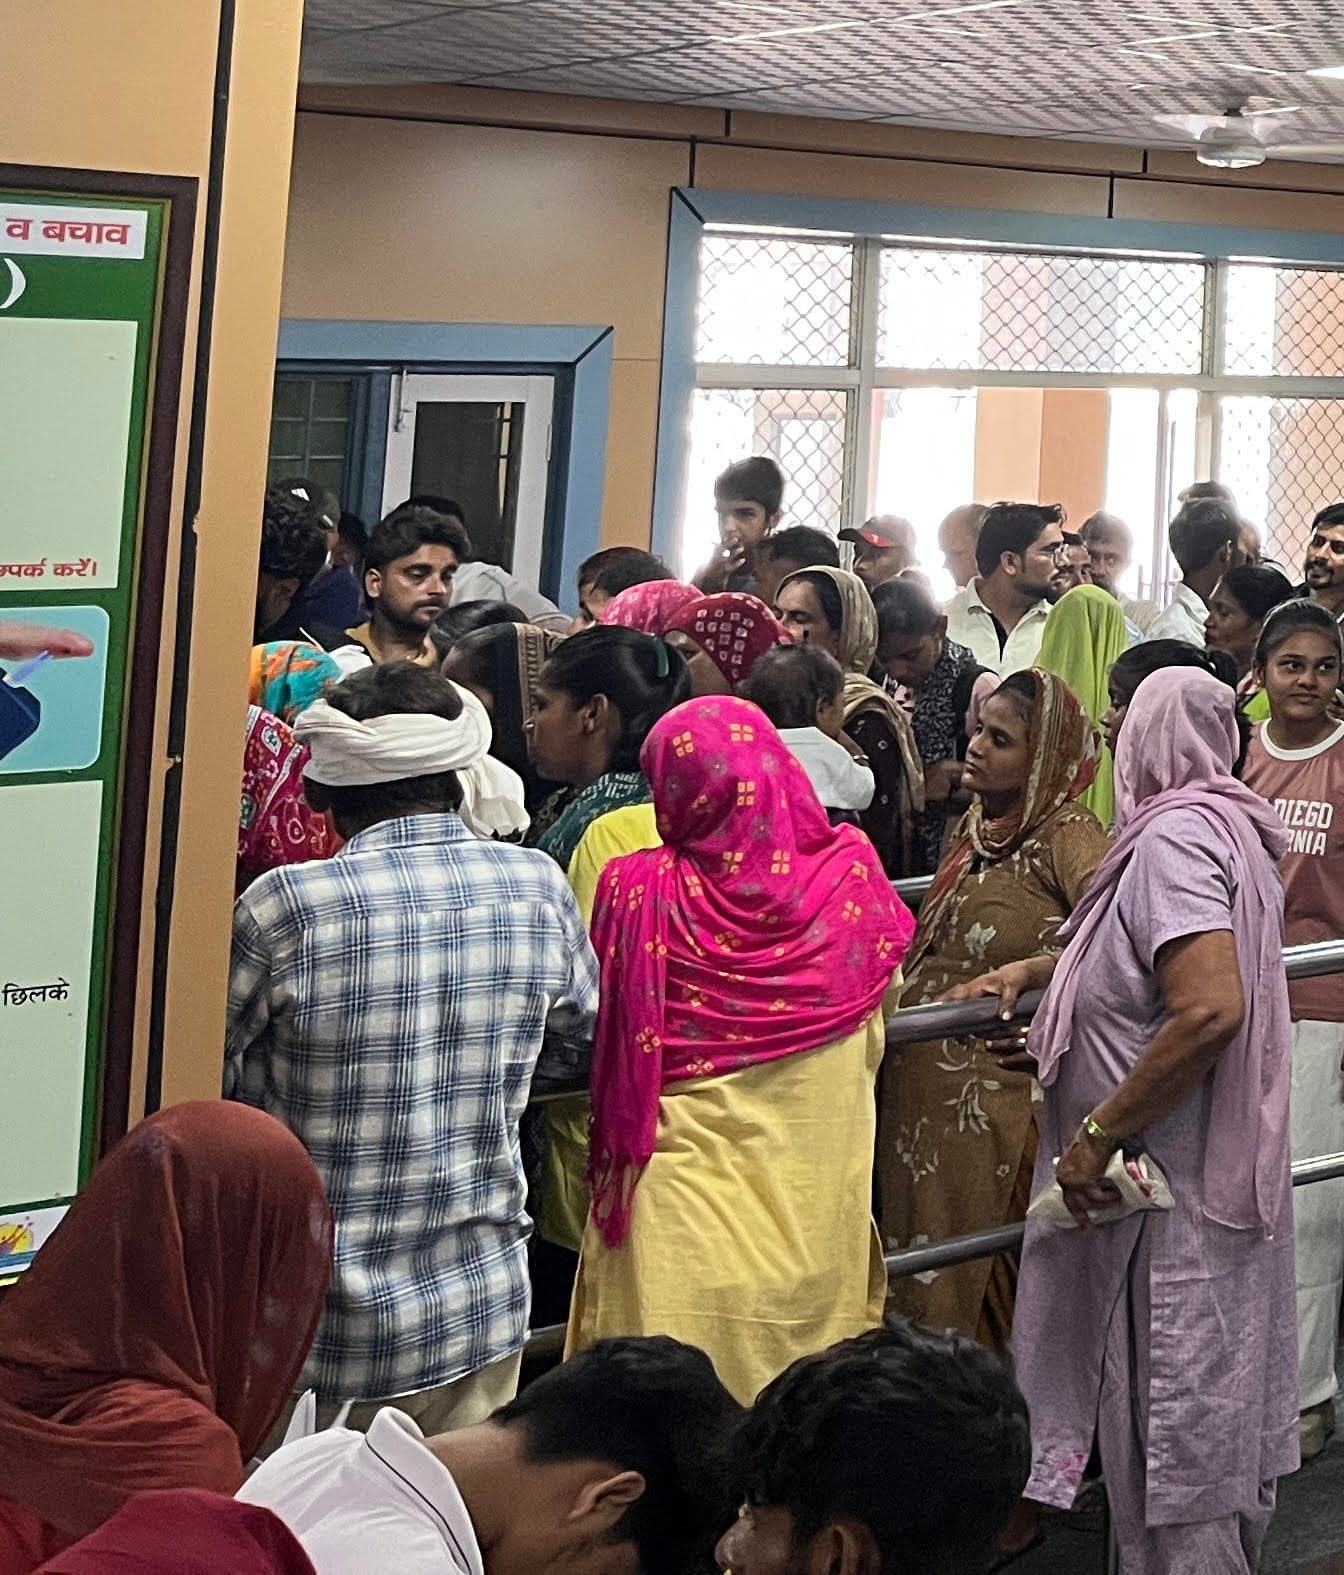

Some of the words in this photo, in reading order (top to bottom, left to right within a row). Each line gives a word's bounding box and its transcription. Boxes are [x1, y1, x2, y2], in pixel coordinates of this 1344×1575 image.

[6, 218, 33, 240] व
[42, 220, 131, 245] बचाव
[53, 557, 97, 576] करें।
[1274, 798, 1334, 830] DIEGO
[1287, 828, 1327, 857] RNIA
[1, 977, 70, 1006] छिलके
